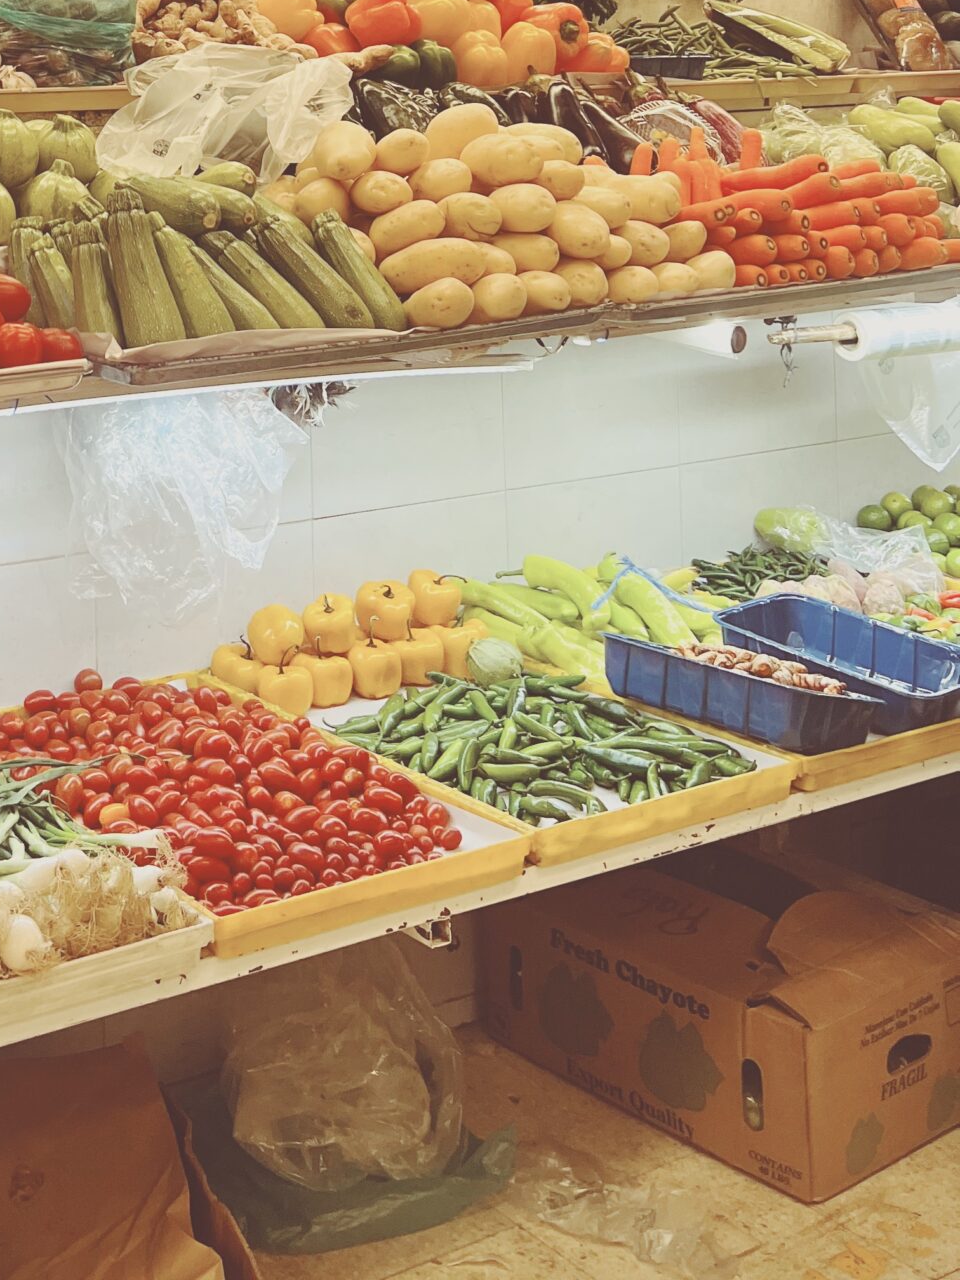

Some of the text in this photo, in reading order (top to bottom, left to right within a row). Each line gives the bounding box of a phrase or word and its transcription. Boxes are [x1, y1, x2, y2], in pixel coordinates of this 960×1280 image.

[550, 927, 711, 1021] Fresh Chayote
[566, 1058, 694, 1139] Export Quality
[880, 1063, 928, 1101] FRAGIL
